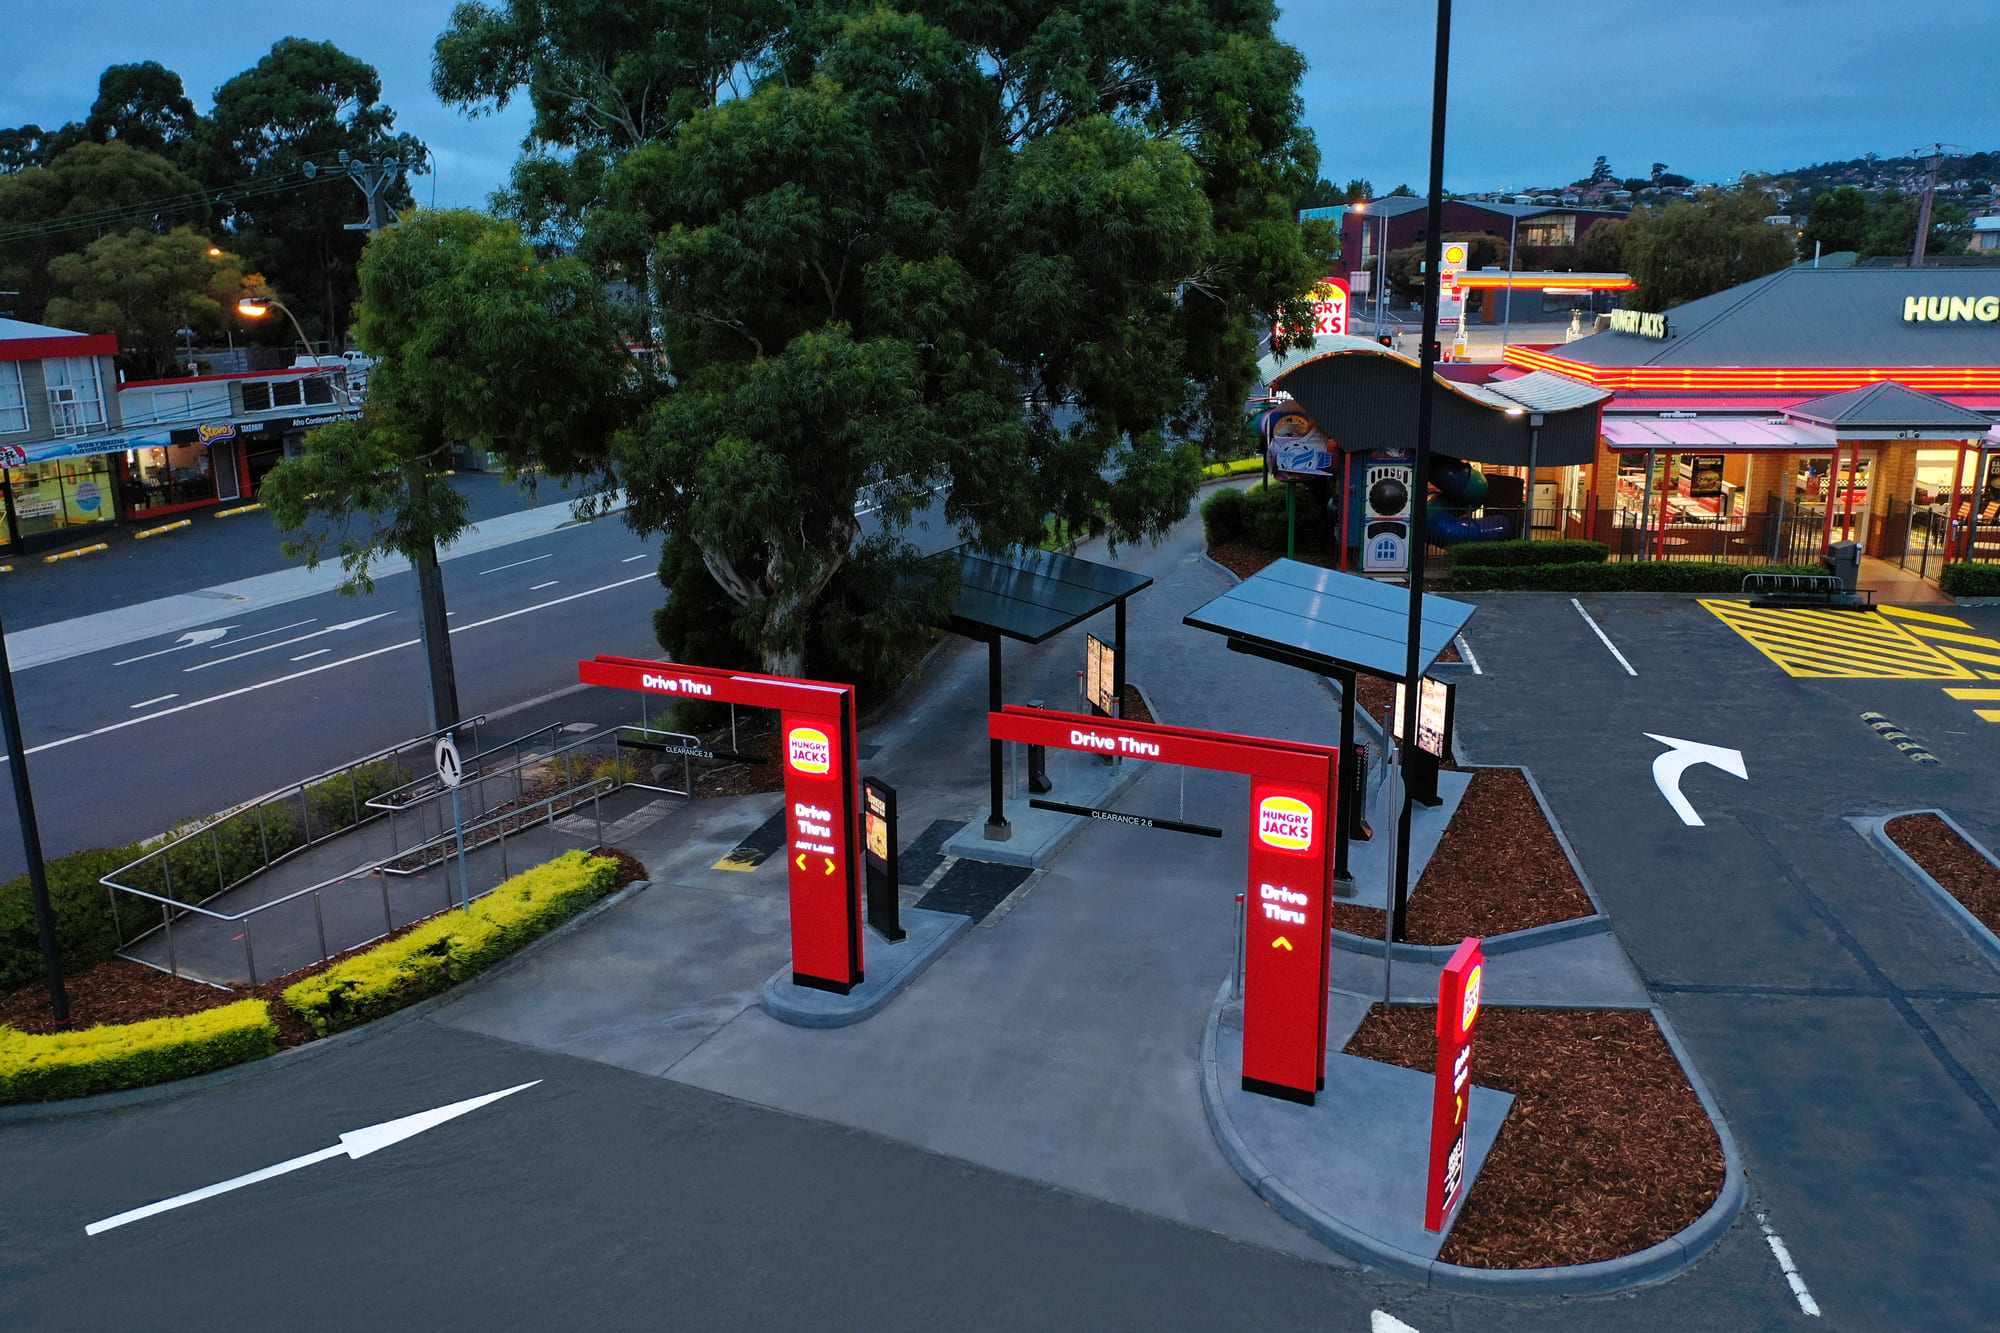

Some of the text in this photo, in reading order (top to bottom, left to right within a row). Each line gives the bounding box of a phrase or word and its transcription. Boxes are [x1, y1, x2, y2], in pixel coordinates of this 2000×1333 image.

[1903, 296, 2000, 322] HUNG
[1609, 308, 1641, 334] HUNGRY
[200, 424, 234, 441] Stevo's
[642, 674, 712, 695] Drive Thru
[791, 740, 826, 752] HUNGRY
[1070, 730, 1160, 756] Drive Thru
[665, 746, 714, 759] CLEARANCE 2.6
[795, 804, 831, 821] Drive
[1091, 810, 1153, 828] CLEARANCE 2.6
[1262, 810, 1309, 825] HUNGRY
[798, 820, 831, 837] Thru
[795, 841, 835, 854] ANY LANE
[1260, 882, 1308, 907] Drive
[1263, 902, 1306, 925] Thru
